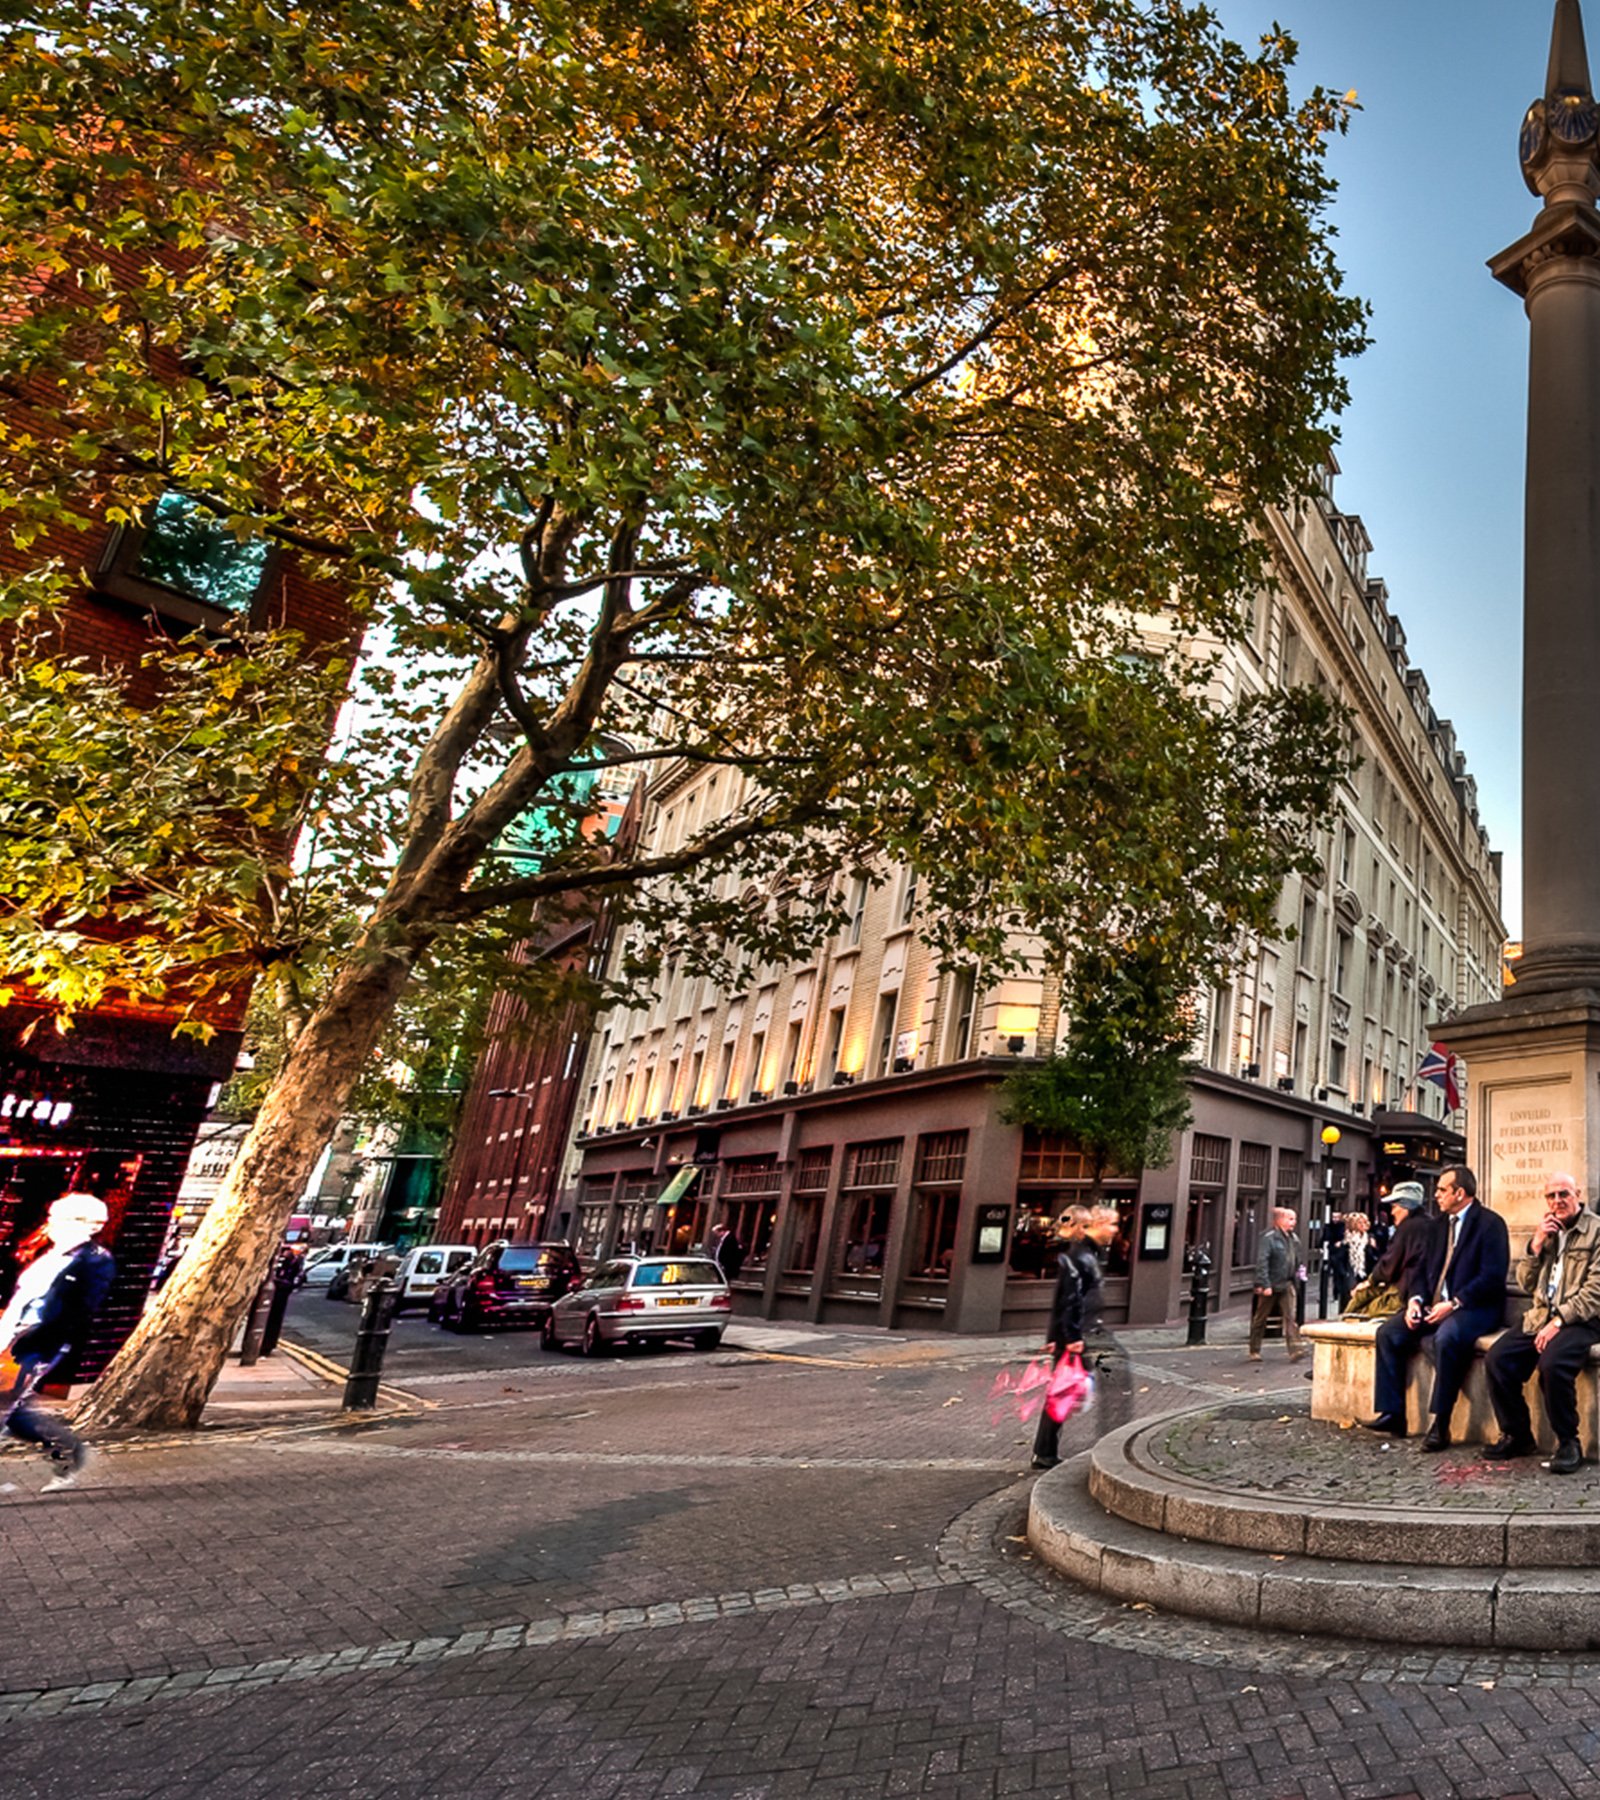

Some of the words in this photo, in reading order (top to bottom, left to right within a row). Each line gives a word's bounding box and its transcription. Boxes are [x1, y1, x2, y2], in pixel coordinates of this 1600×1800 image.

[1, 1093, 73, 1125] trap
[1510, 1109, 1551, 1121] UNVEILED
[1528, 1123, 1562, 1136] MAJESTY
[1493, 1141, 1526, 1160] QUEEN
[1528, 1139, 1569, 1153] BEATRIX
